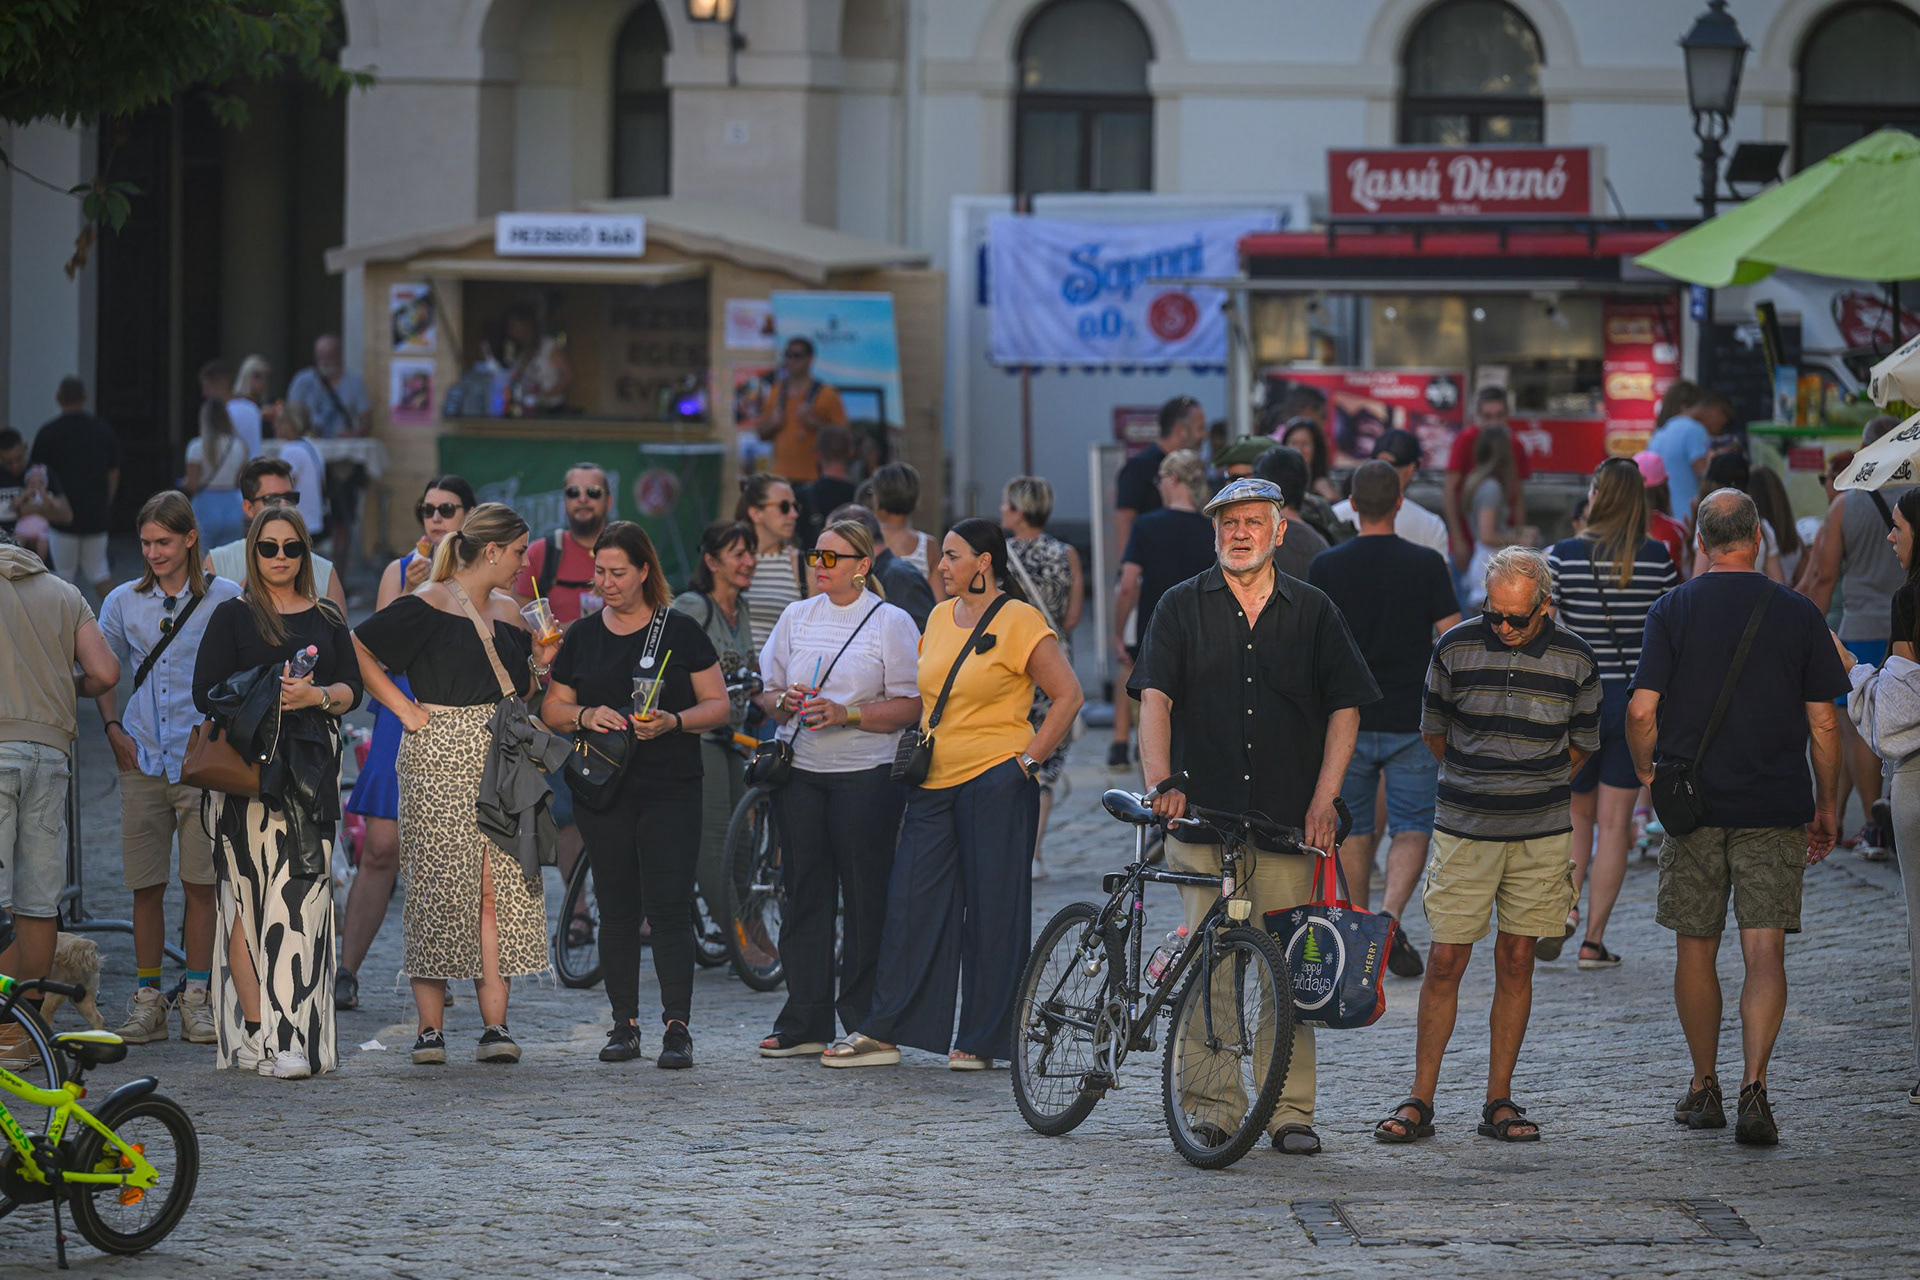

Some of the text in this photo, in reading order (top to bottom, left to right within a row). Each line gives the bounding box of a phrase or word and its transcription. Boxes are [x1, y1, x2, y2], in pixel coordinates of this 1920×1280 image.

[1347, 154, 1568, 212] Lassú Disznó
[649, 625, 661, 650] BEVERLY
[1364, 940, 1378, 974] MERRY
